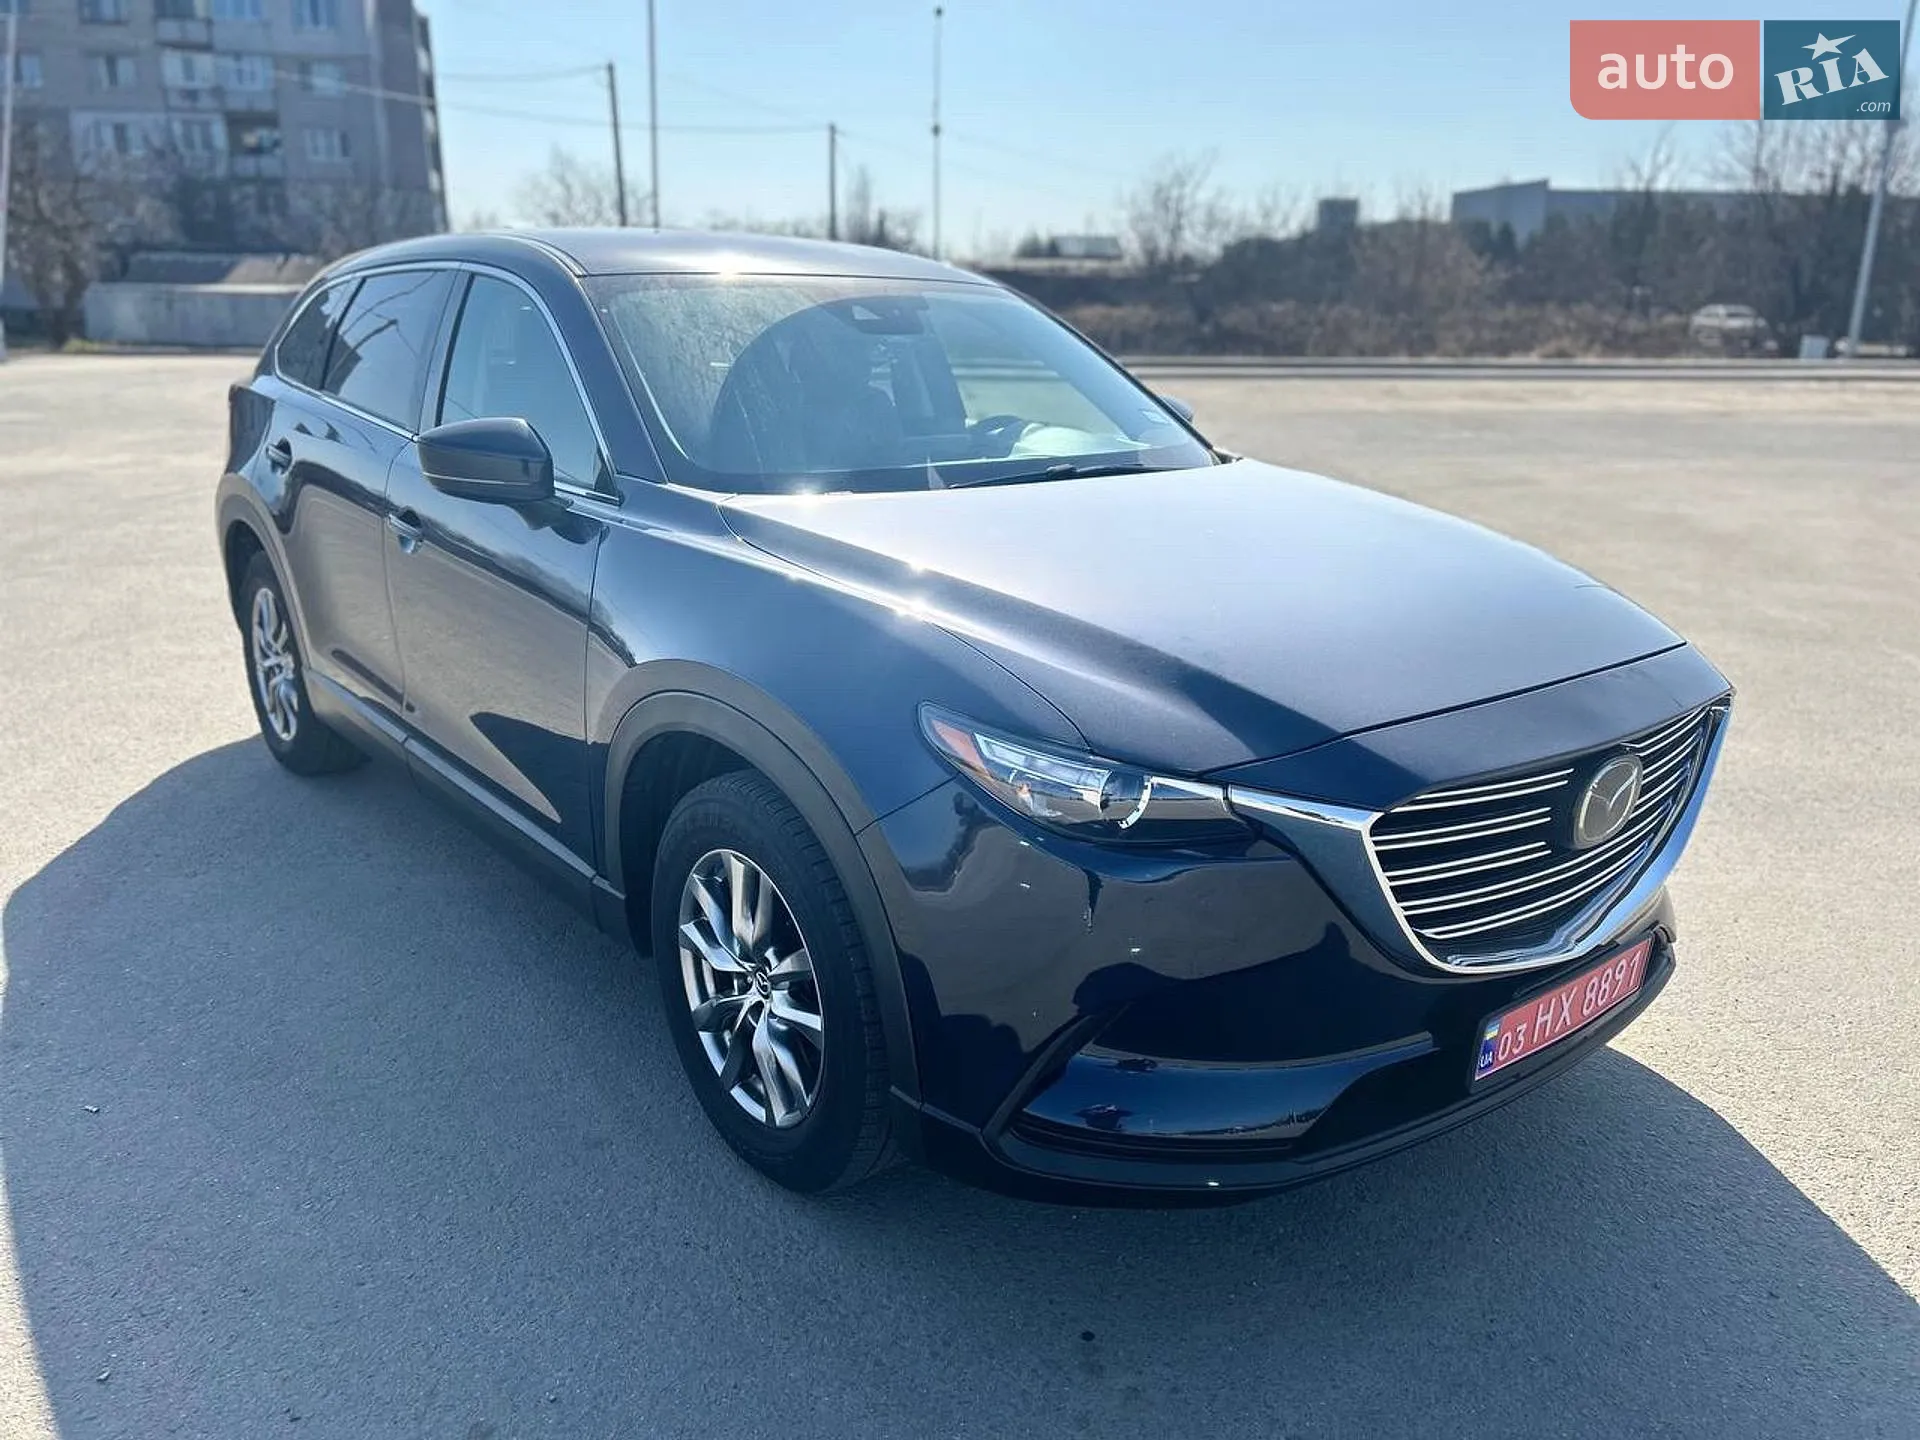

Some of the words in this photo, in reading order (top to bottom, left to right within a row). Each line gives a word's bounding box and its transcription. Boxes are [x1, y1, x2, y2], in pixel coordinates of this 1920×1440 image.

[1498, 1022, 1527, 1060] 03
[1533, 988, 1576, 1044] HX
[1582, 951, 1642, 1016] 8891
